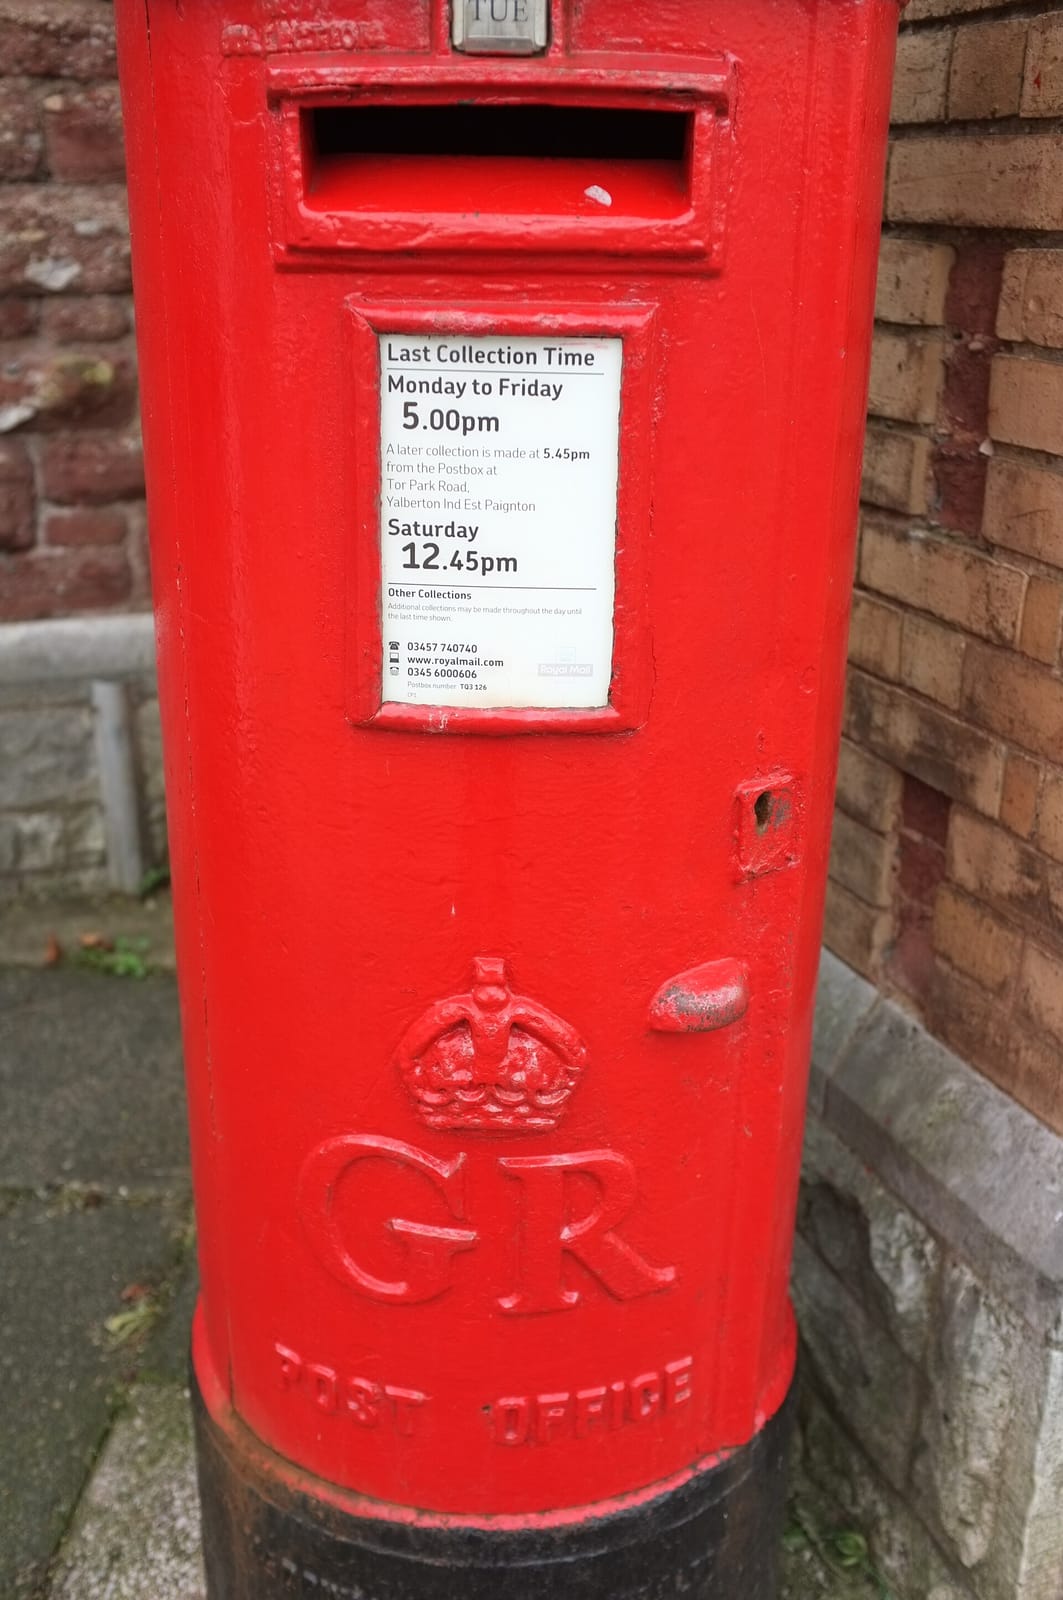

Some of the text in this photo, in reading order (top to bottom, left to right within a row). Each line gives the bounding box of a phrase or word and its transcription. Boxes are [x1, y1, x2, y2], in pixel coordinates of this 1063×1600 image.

[388, 344, 594, 366] Last Collection Time
[388, 376, 562, 400] Monday to Friday
[402, 402, 499, 436] 5.00pm
[386, 444, 590, 461] A later collection is made at 5.45pm
[386, 462, 497, 475] from the Postbox at
[387, 479, 470, 493] Tor Park Road,
[386, 497, 535, 513] Yalberton Ind Est Paignton
[389, 519, 478, 541] Saturday
[402, 543, 517, 576] 12.45pm
[389, 589, 471, 600] Other Collections
[388, 603, 421, 611] Additional
[422, 604, 456, 613] collections
[458, 606, 472, 615] may
[503, 606, 540, 616] throughout
[541, 607, 552, 615] the
[554, 607, 566, 616] day
[400, 613, 411, 621] last
[408, 643, 477, 653] 03457 740740
[408, 656, 504, 667] www.royalmail.com
[408, 668, 477, 679] 0345 6000606
[541, 665, 567, 675] Royal
[408, 681, 431, 689] Postbox
[274, 1340, 693, 1446] POST OFFICE
